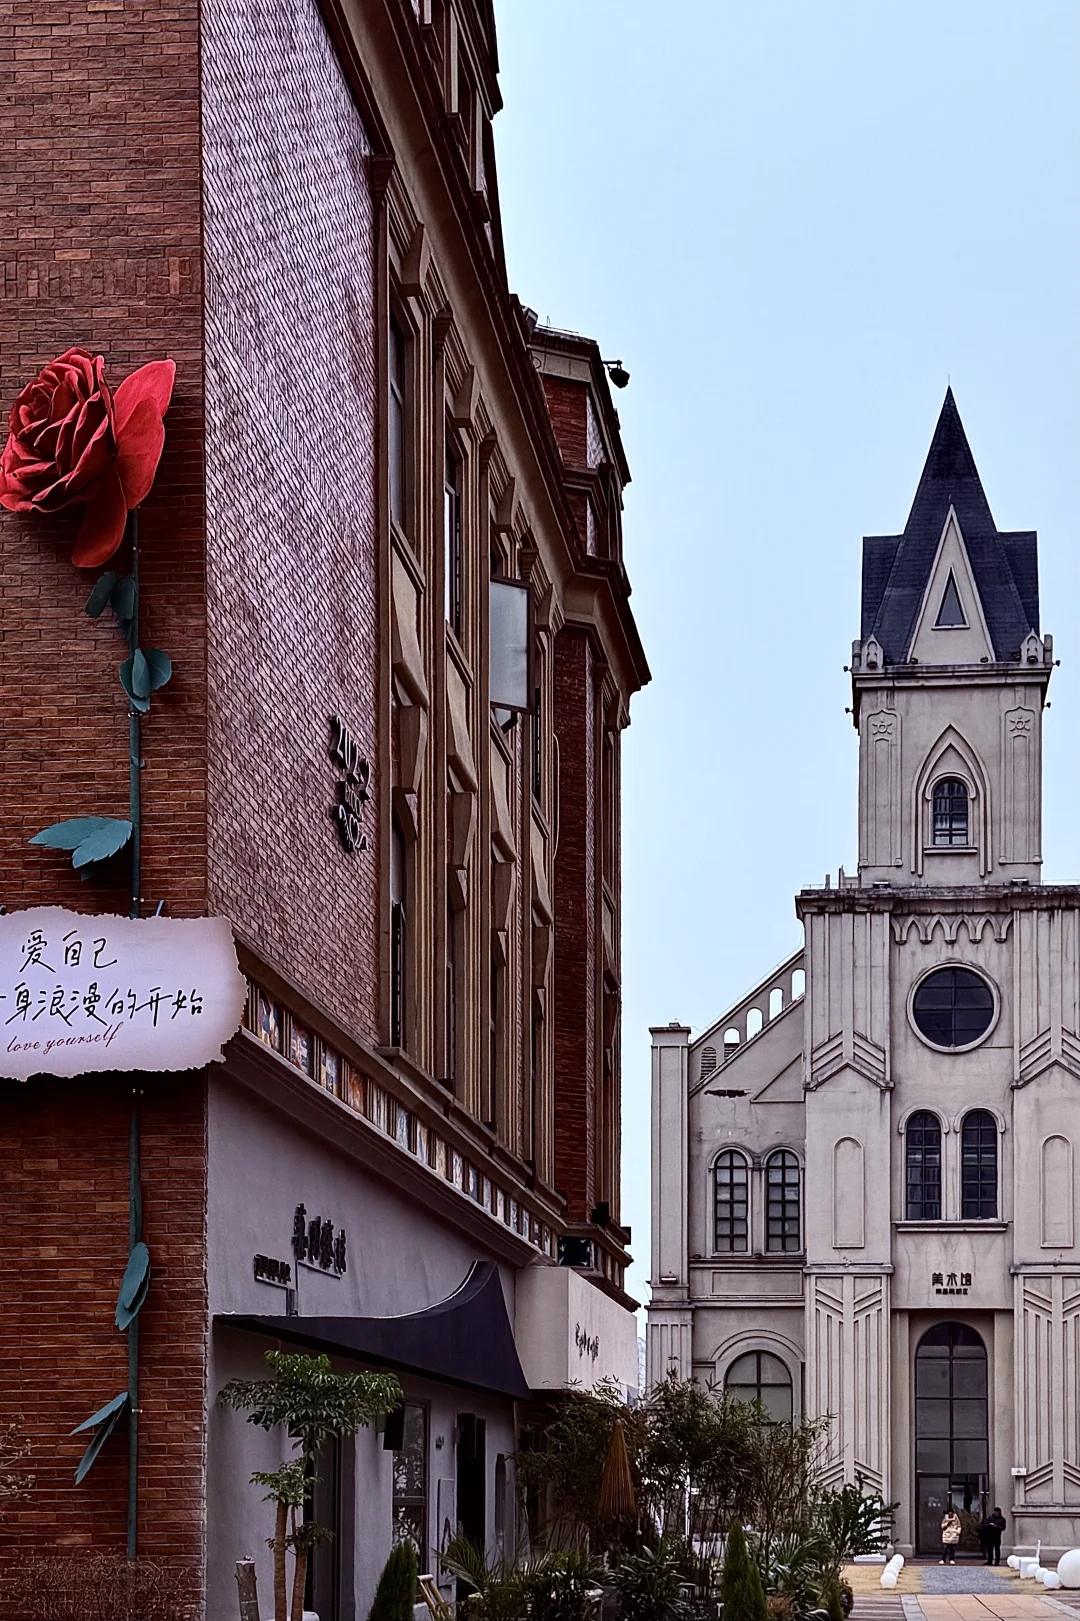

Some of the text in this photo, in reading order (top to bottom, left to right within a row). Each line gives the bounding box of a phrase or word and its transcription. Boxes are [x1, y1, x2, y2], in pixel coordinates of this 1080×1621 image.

[19, 929, 118, 973] 爱自己
[0, 982, 204, 1027] 身浪漫的开始
[7, 1022, 124, 1054] love yourself
[932, 1272, 972, 1286] 美术馆
